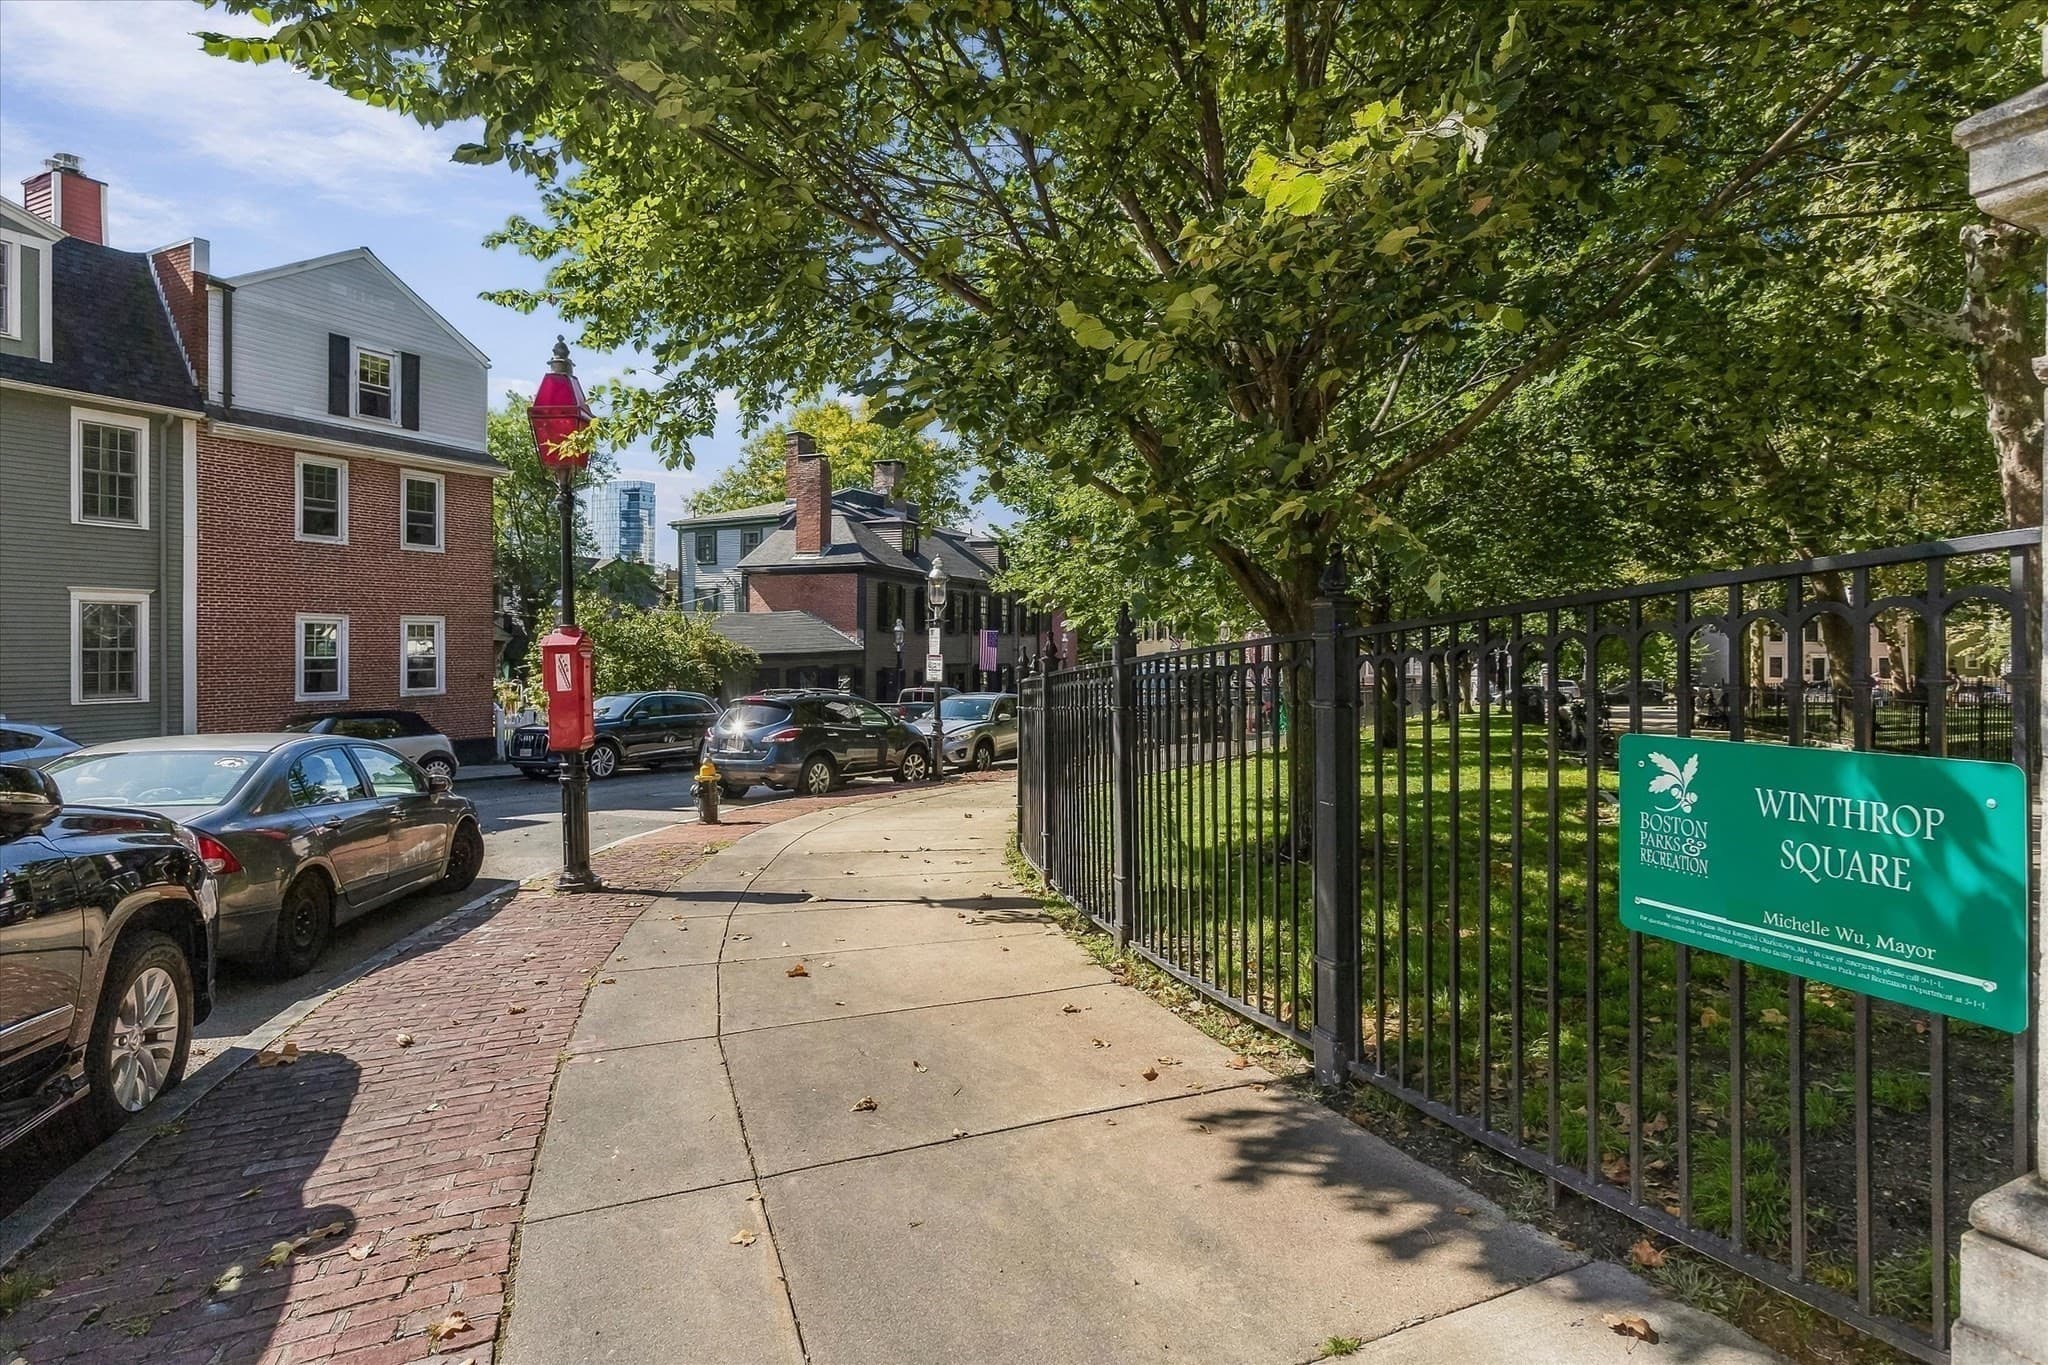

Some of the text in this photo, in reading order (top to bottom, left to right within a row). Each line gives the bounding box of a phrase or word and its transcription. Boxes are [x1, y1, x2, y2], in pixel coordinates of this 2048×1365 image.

[1640, 811, 1708, 839] BOSTON
[1755, 787, 1945, 841] WINTHROP
[1640, 831, 1706, 856] PARKS &
[1640, 848, 1708, 874] RECREATION
[1780, 839, 1912, 892] SQUARE
[1763, 911, 1830, 937] Michelle
[1835, 926, 1871, 949] Wu,
[1876, 935, 1936, 960] Mayor
